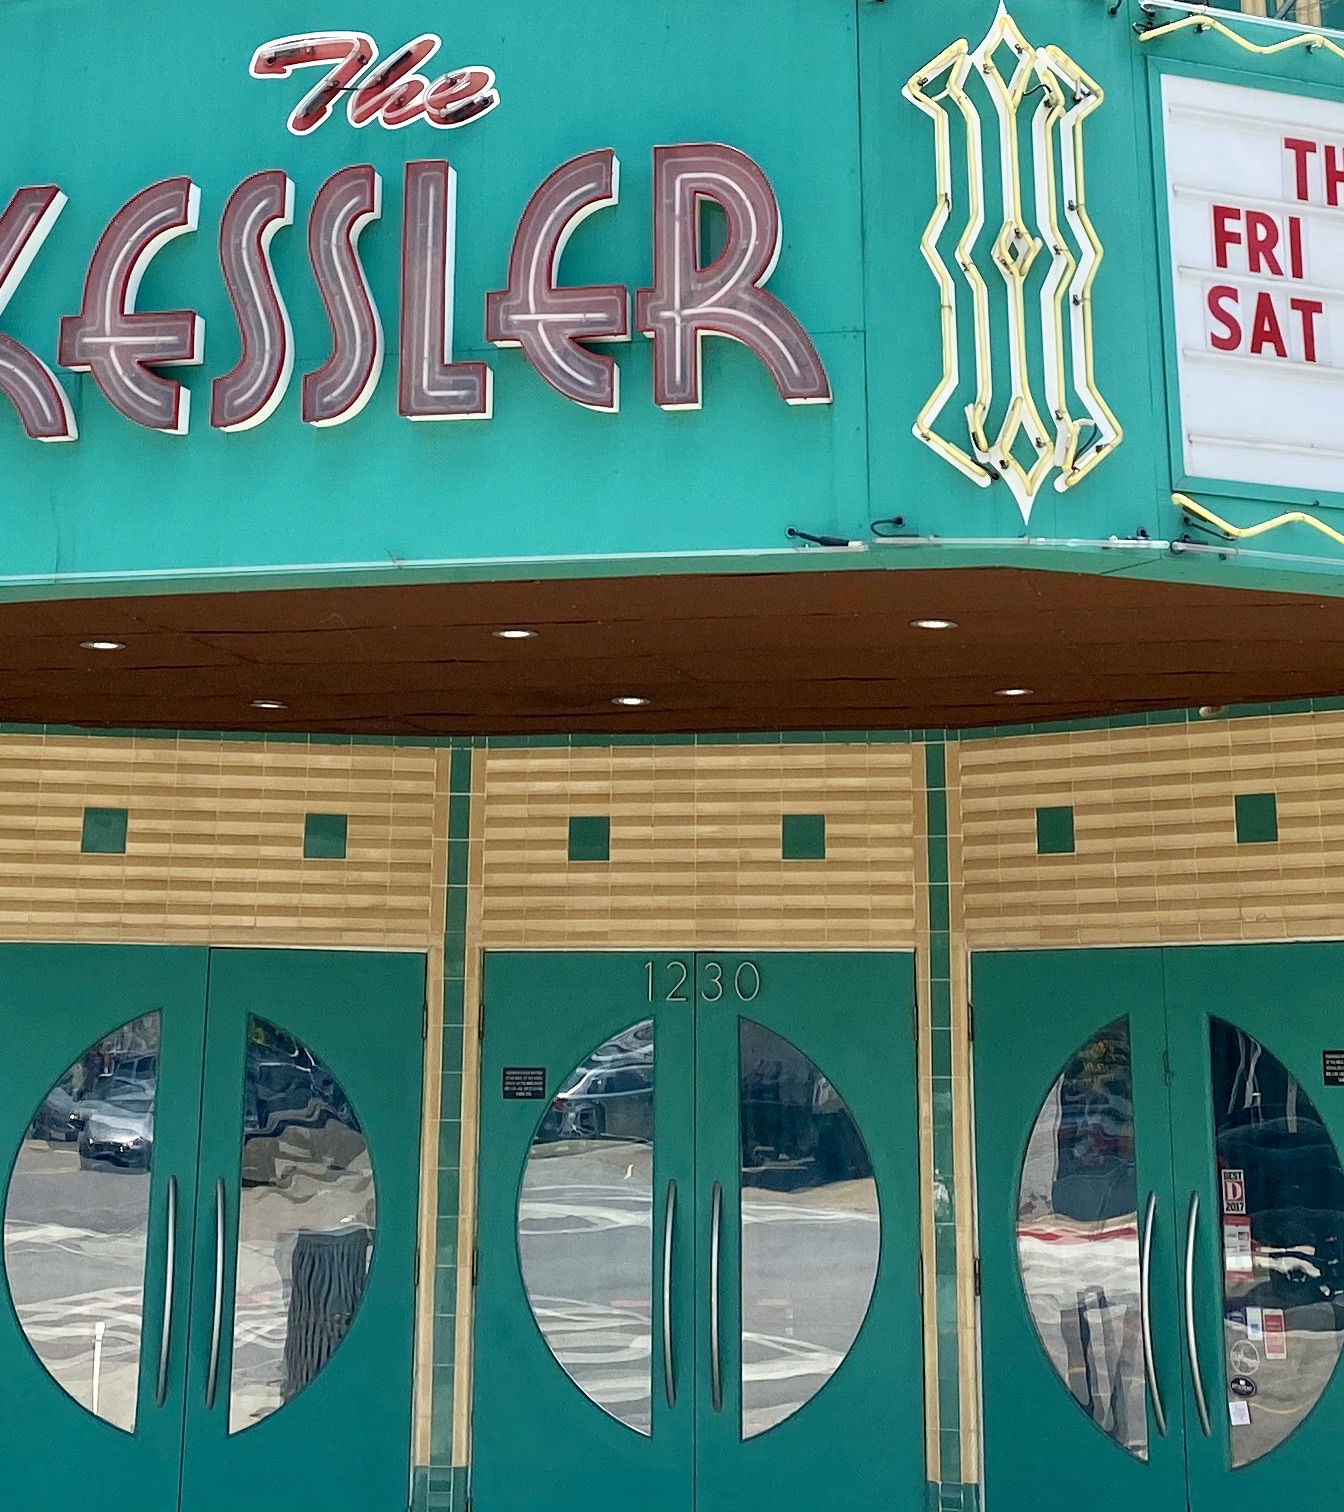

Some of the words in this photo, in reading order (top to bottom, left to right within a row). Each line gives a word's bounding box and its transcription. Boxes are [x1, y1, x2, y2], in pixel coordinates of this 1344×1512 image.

[249, 30, 501, 135] The
[1210, 203, 1306, 280] FRI
[1207, 284, 1324, 363] SAT
[642, 960, 760, 1002] 1230
[1223, 1171, 1243, 1180] BEST
[1225, 1180, 1244, 1202] D
[1225, 1202, 1245, 1212] 2017
